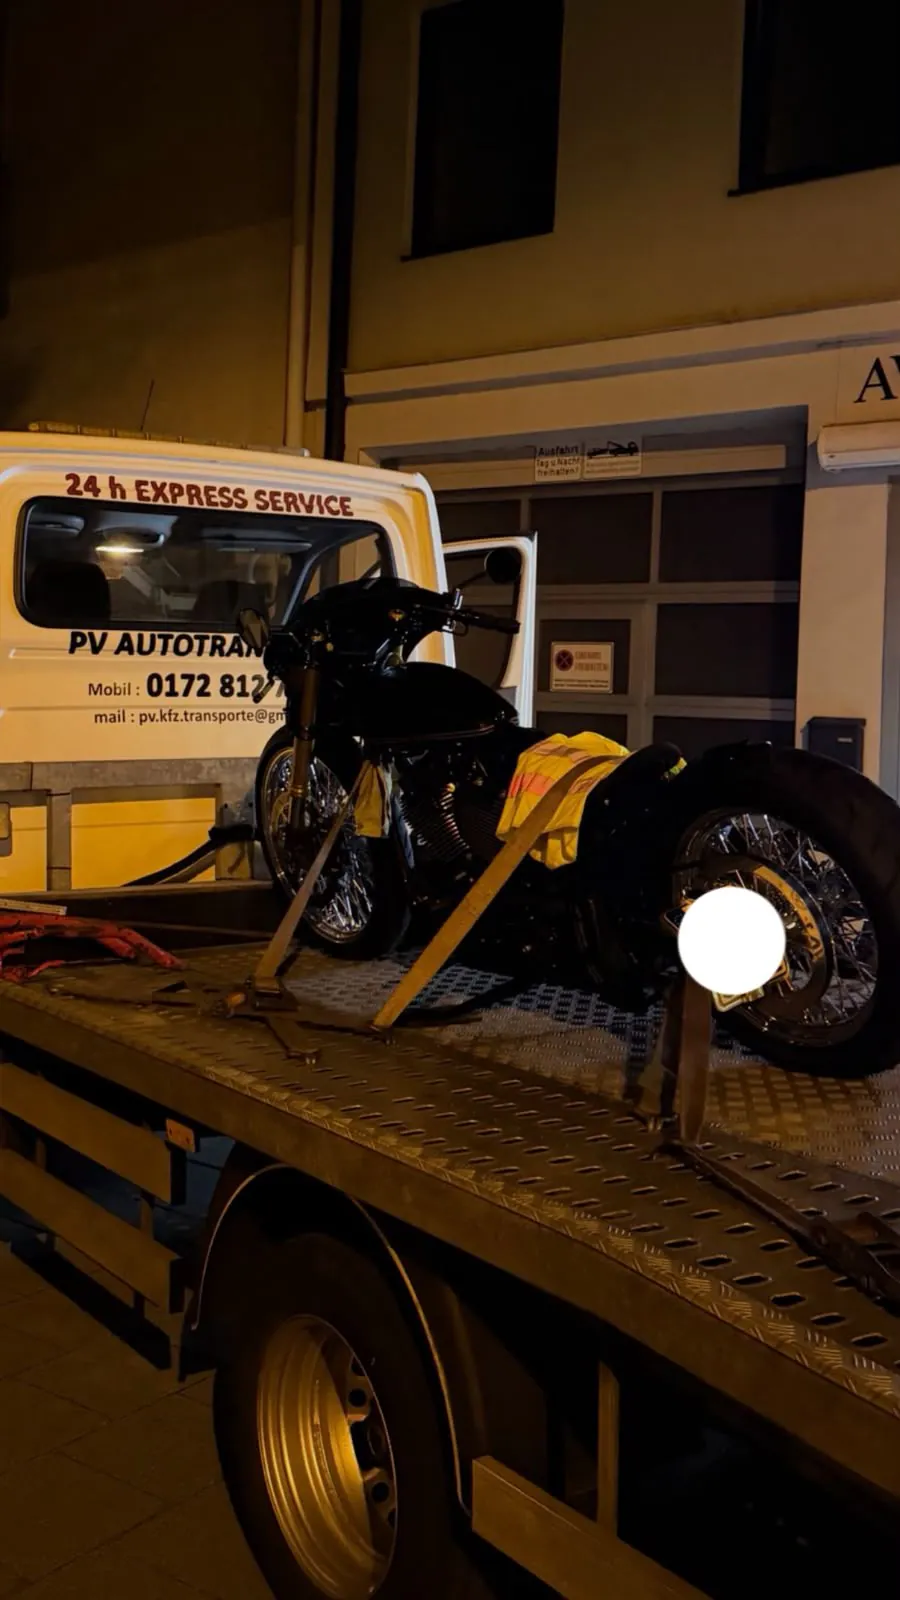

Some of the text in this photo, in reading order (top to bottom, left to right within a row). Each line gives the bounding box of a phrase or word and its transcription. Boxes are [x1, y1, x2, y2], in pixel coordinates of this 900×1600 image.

[538, 445, 579, 456] Ausfahrt
[65, 474, 354, 517] 24 h EXPRESS SERVICE
[68, 631, 108, 655] PV
[88, 682, 132, 696] Mobil
[147, 673, 211, 698] 0172
[94, 709, 126, 724] mail
